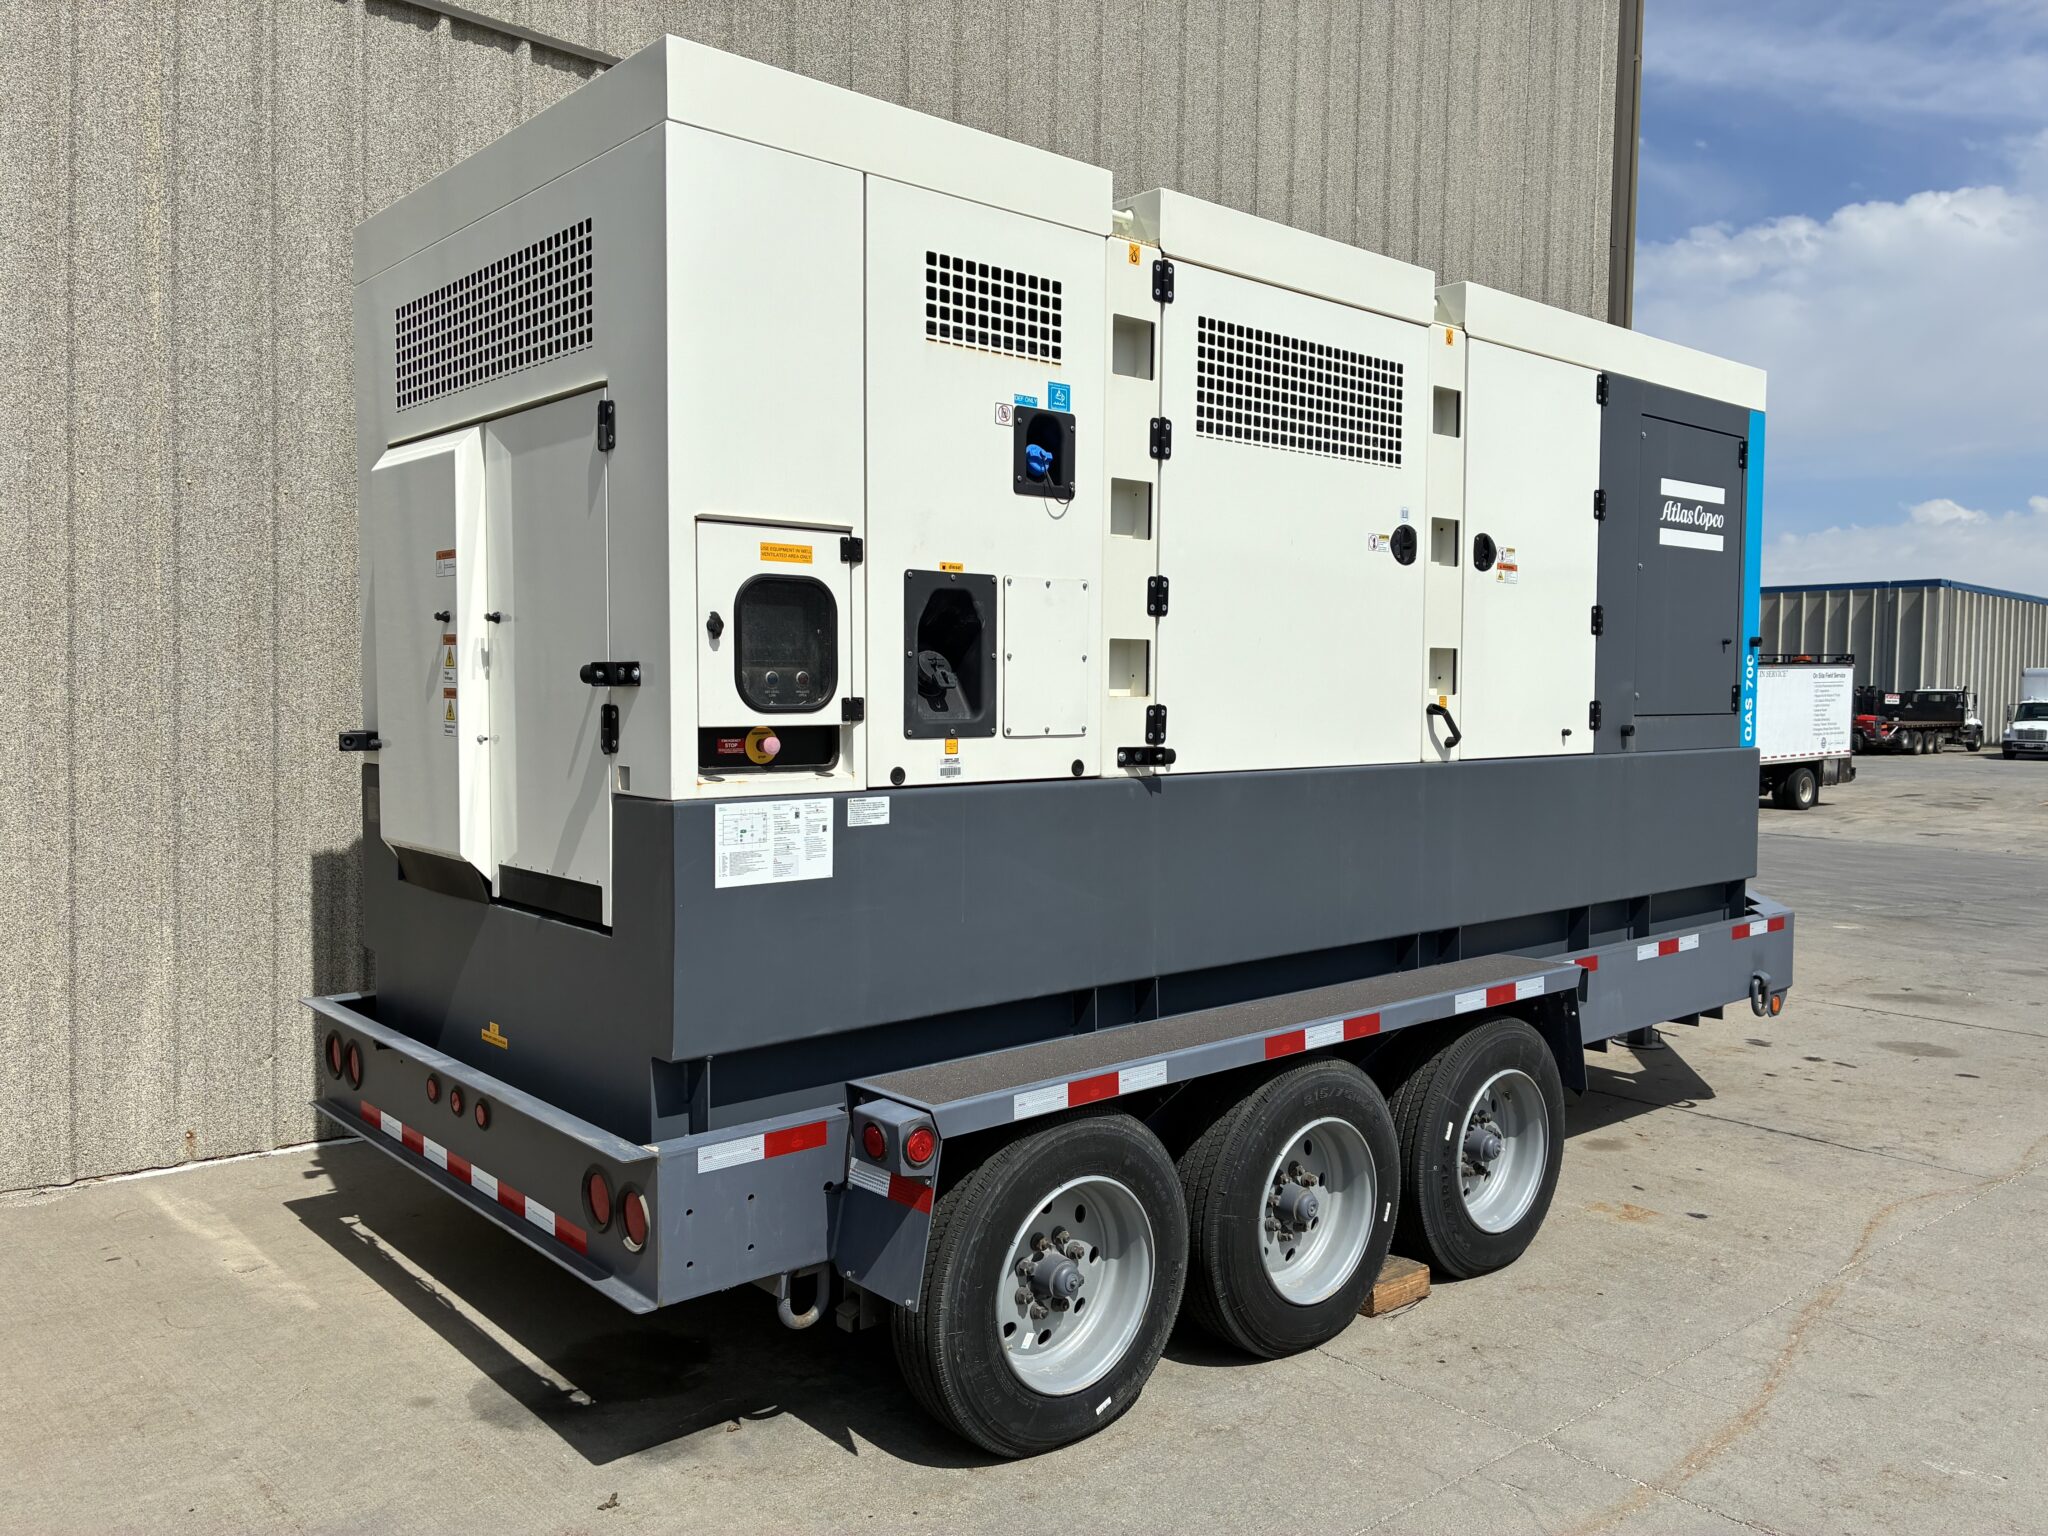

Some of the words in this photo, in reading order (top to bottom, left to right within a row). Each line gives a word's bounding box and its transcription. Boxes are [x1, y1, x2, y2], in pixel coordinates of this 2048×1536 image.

[1025, 396, 1038, 404] ONLY
[1660, 500, 1694, 524] Atlas
[1694, 505, 1724, 531] Copco
[1744, 697, 1754, 741] QAS
